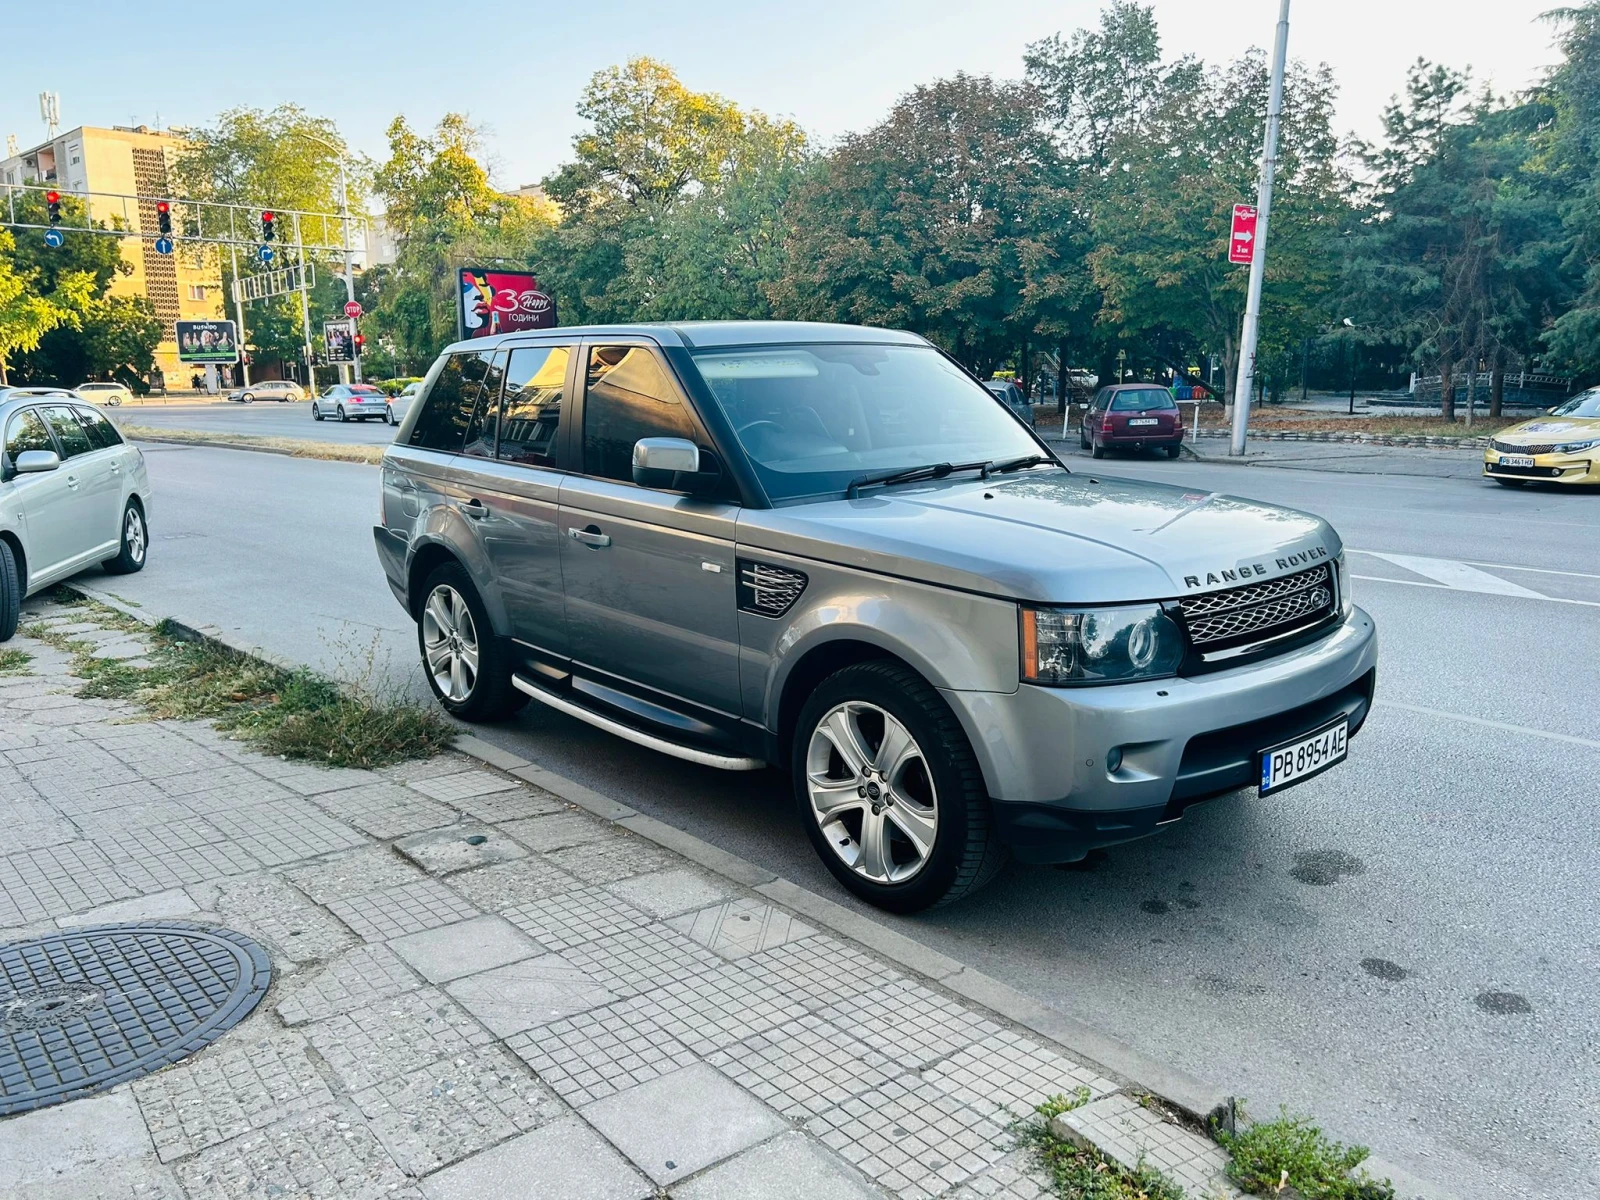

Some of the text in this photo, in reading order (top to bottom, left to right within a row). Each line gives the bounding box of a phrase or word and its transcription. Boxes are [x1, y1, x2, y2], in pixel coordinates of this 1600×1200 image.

[520, 295, 549, 309] Happy
[346, 306, 360, 314] STOP
[508, 313, 539, 323] ГОДИНИ
[1502, 457, 1511, 465] PB
[1184, 546, 1327, 588] RANGE ROVER
[1273, 726, 1346, 782] PB 8954 AE
